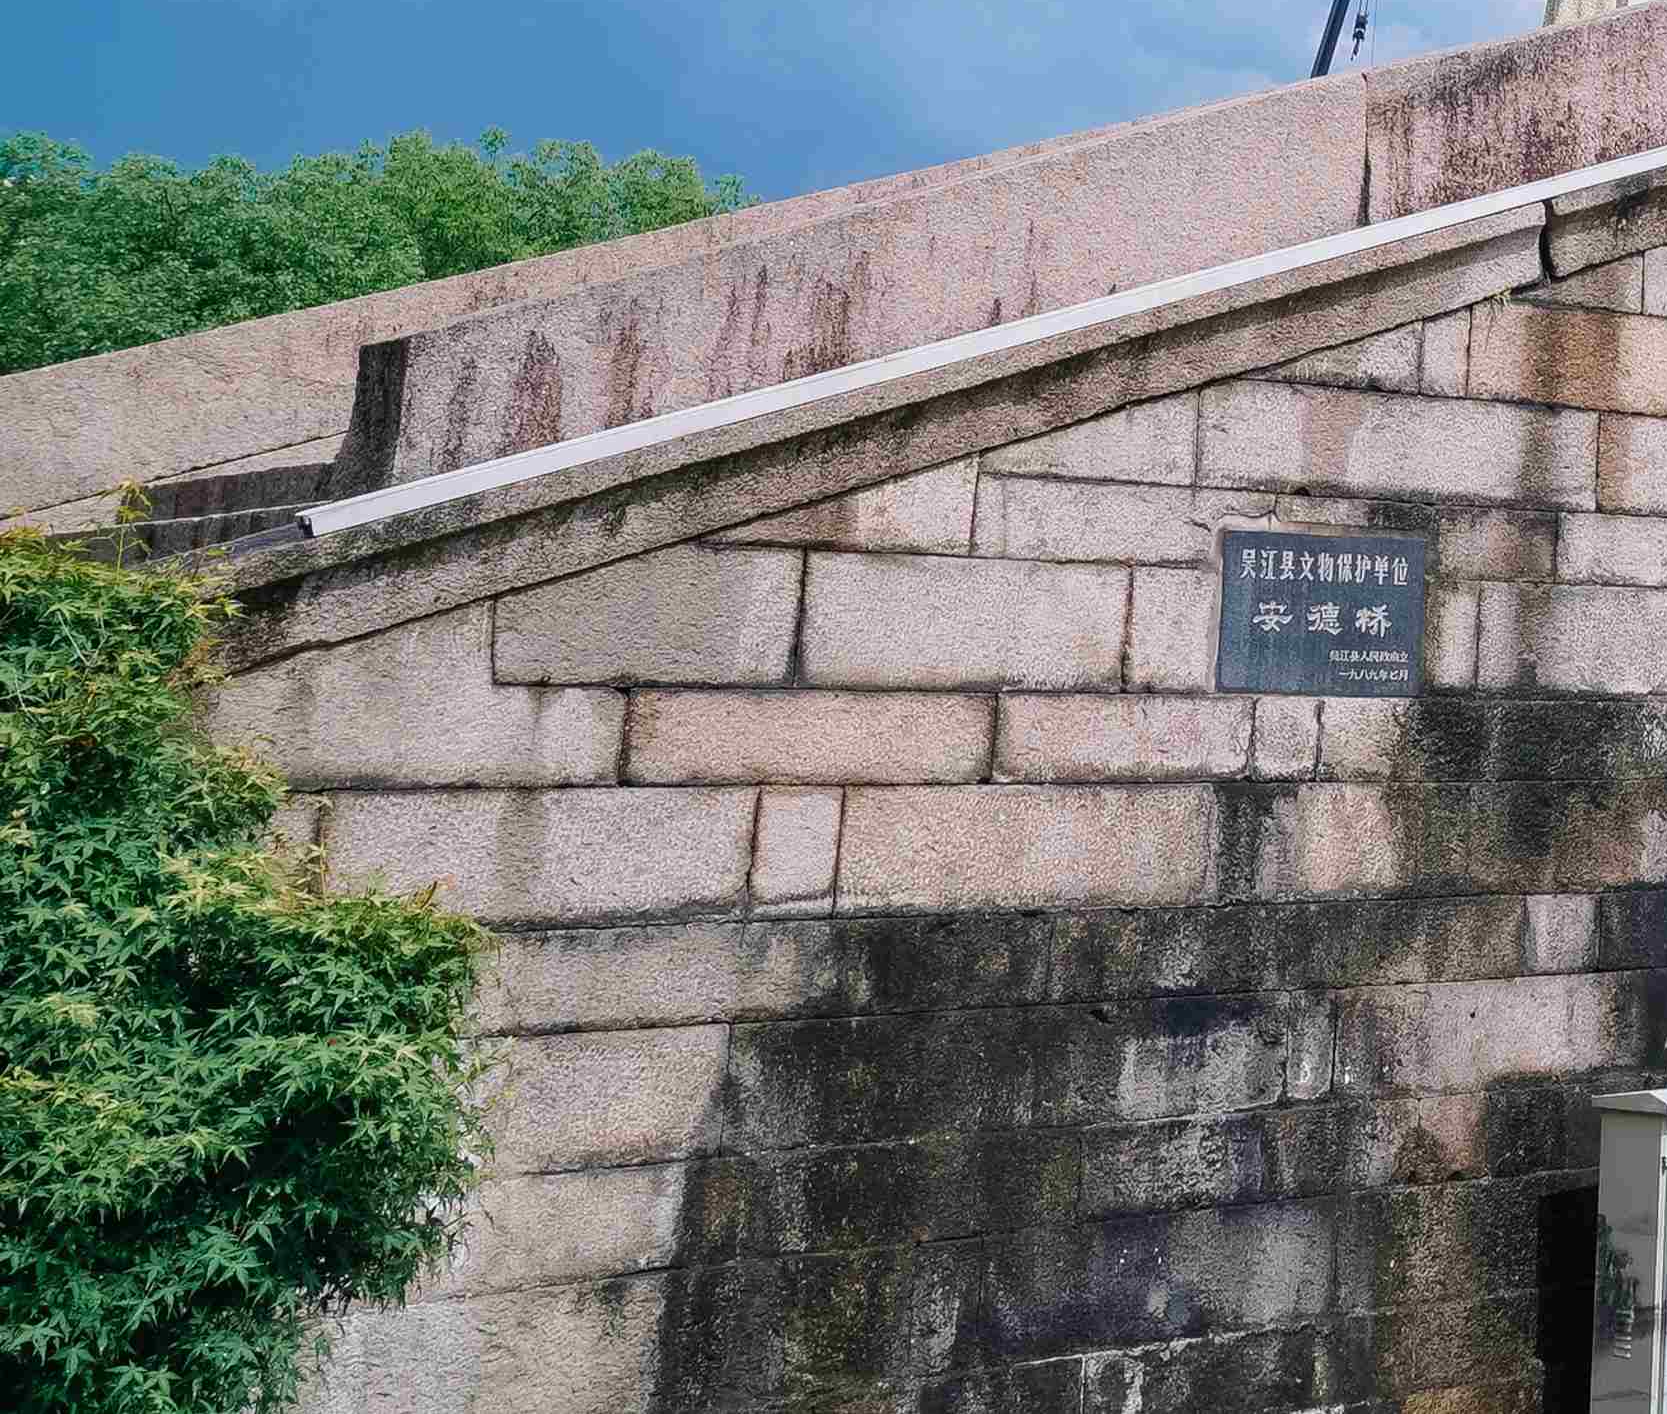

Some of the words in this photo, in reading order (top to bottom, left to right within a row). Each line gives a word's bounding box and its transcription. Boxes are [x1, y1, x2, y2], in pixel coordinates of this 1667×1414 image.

[1240, 548, 1409, 585] 吴江县文物保护单位
[1252, 600, 1393, 638] 安德桥
